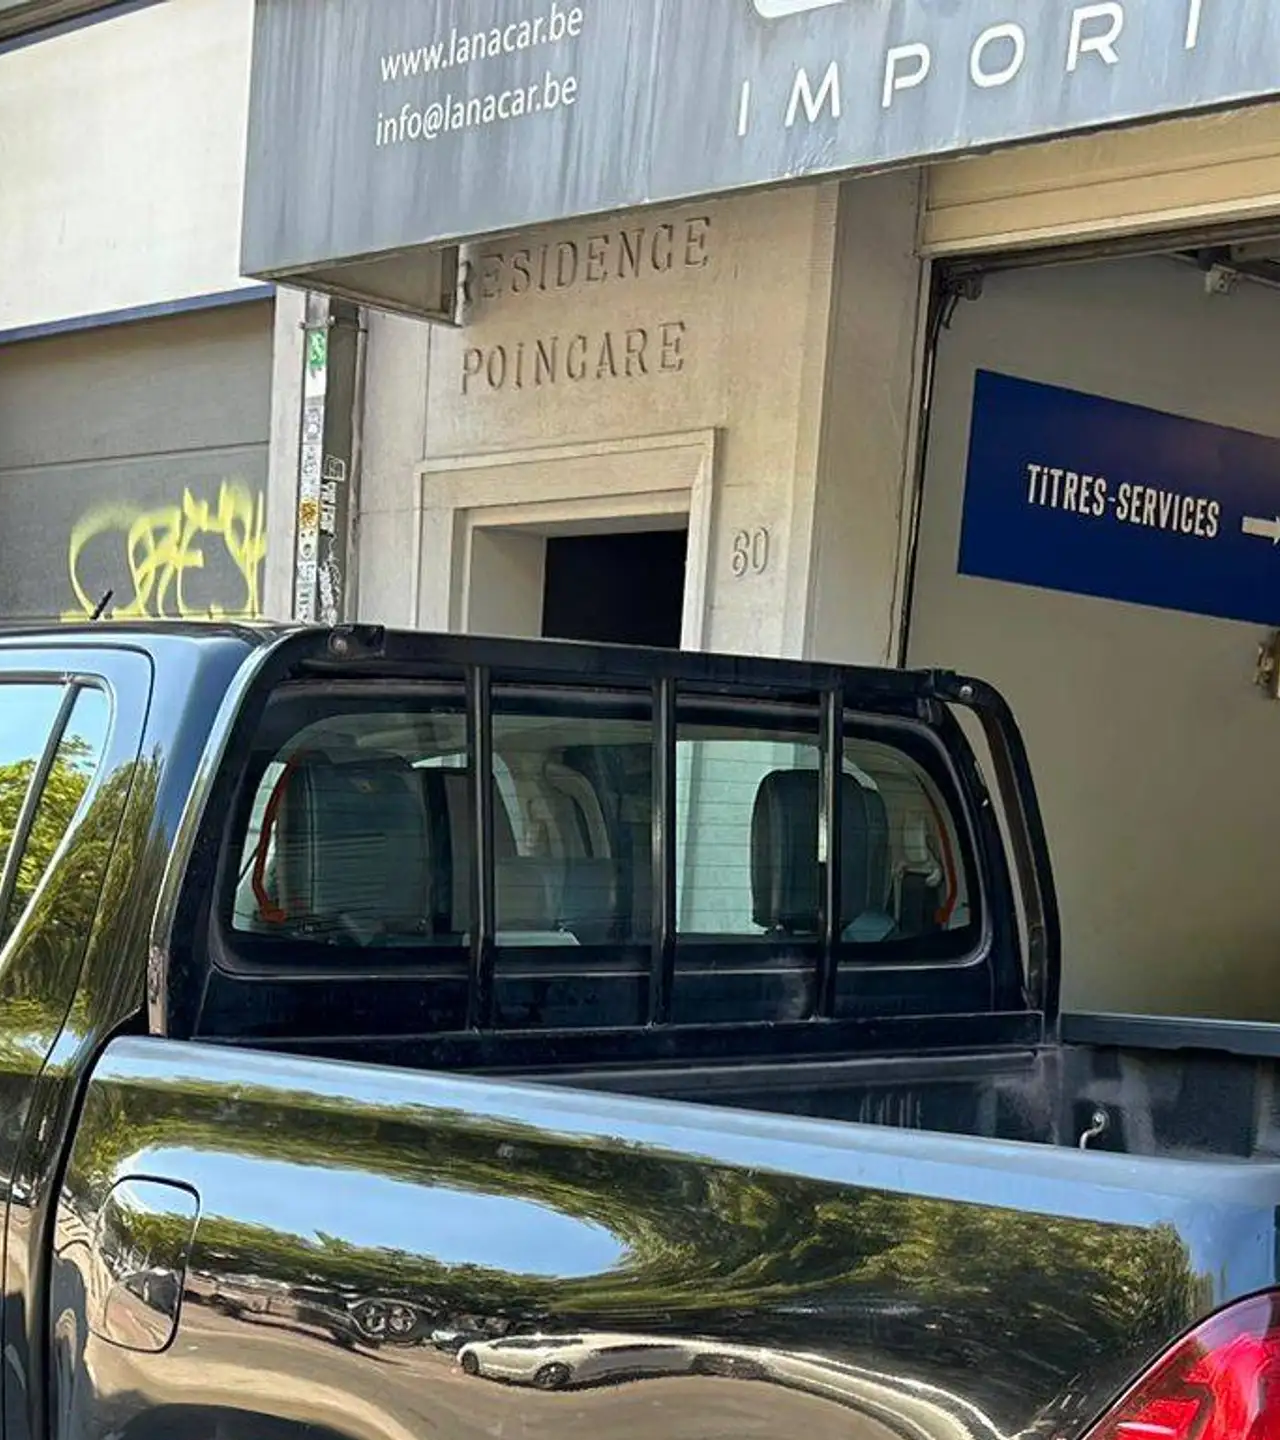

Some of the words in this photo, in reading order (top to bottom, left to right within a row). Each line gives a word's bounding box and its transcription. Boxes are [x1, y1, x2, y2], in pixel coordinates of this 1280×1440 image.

[380, 3, 583, 82] www.lanacar.be
[375, 70, 578, 146] info@lanacar.be
[460, 321, 686, 396] POINCARE
[732, 527, 770, 578] 60
